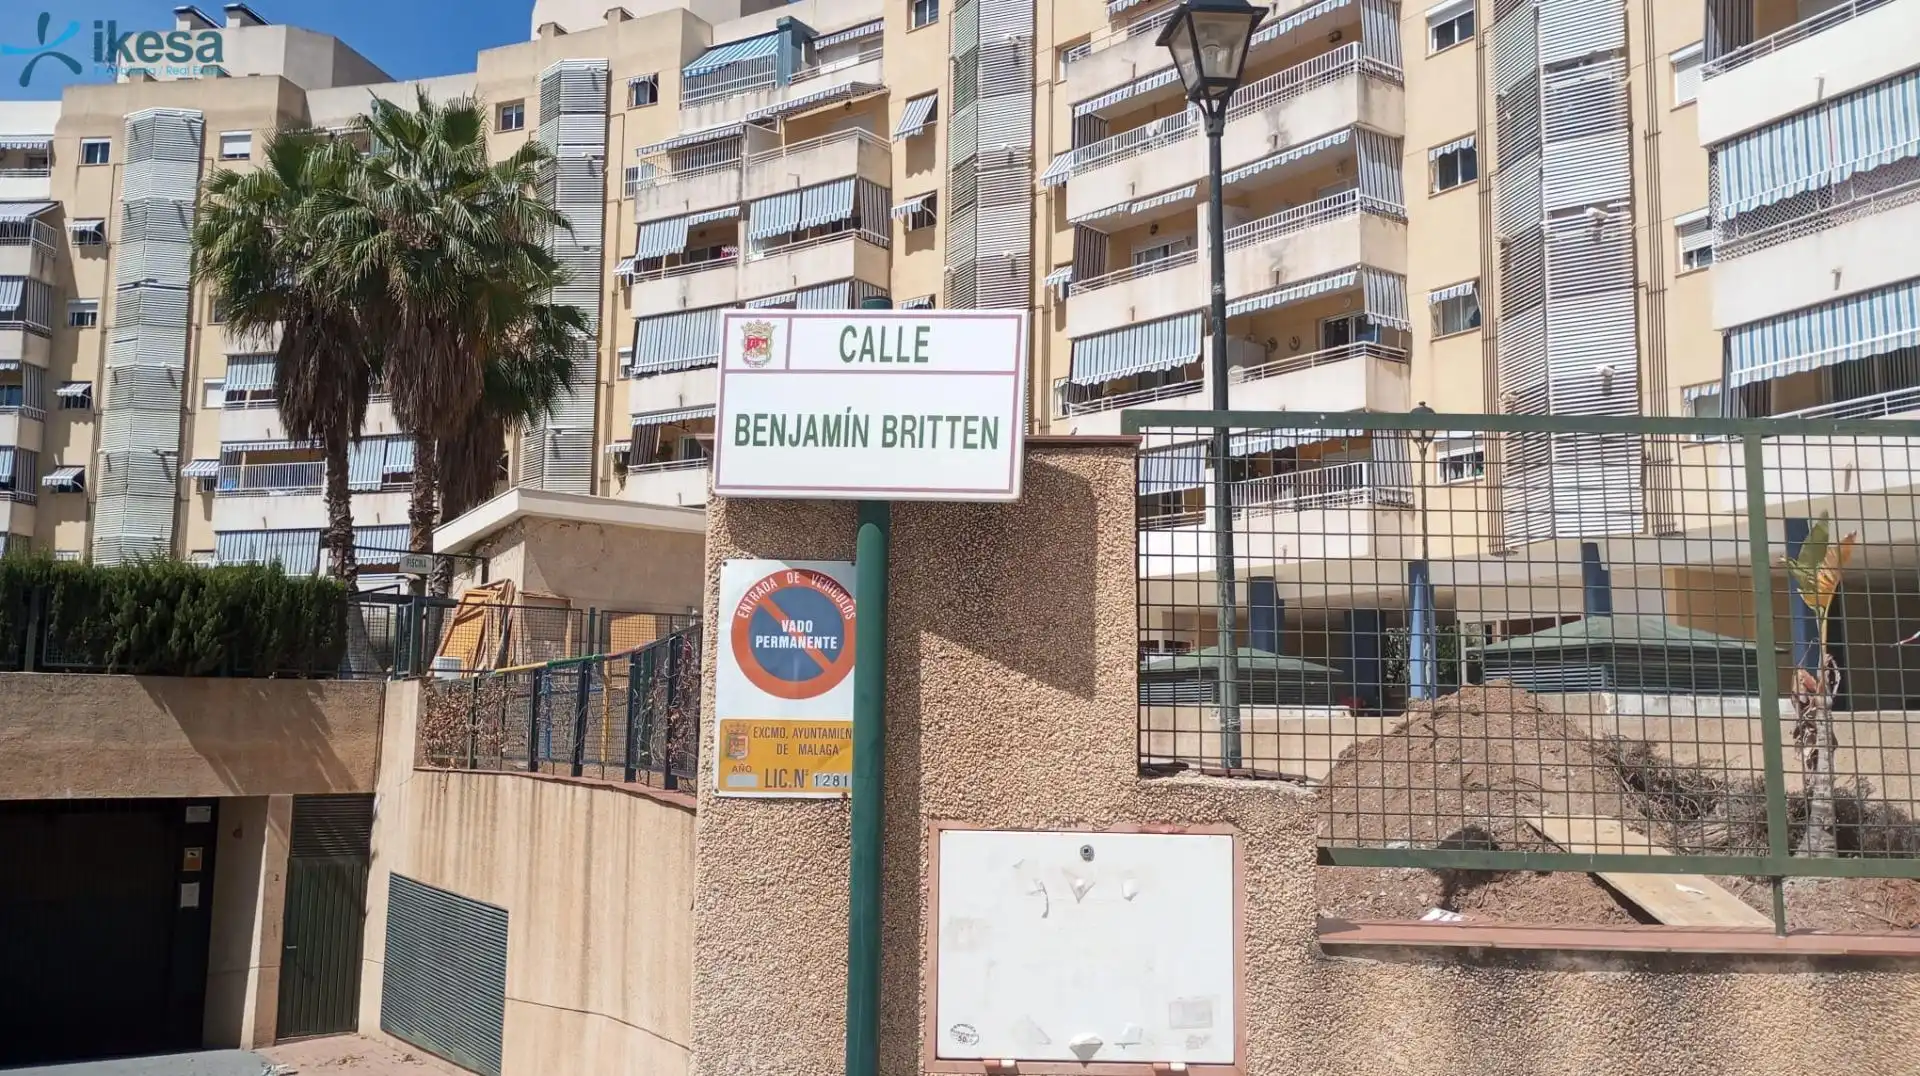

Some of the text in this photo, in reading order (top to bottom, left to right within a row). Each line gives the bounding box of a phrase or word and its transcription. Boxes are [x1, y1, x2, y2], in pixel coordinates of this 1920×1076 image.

[839, 325, 930, 363] CALLE
[734, 406, 998, 449] BENJAMÍN BRITTEN
[738, 571, 856, 619] ENTRADA DE VEHICULOS
[781, 619, 813, 632] VADO
[755, 635, 838, 649] PERMANENTE
[753, 727, 789, 739] EXCMO.
[776, 743, 839, 756] DE MALAGA
[731, 763, 752, 773] AÑO
[814, 774, 849, 787] 1281
